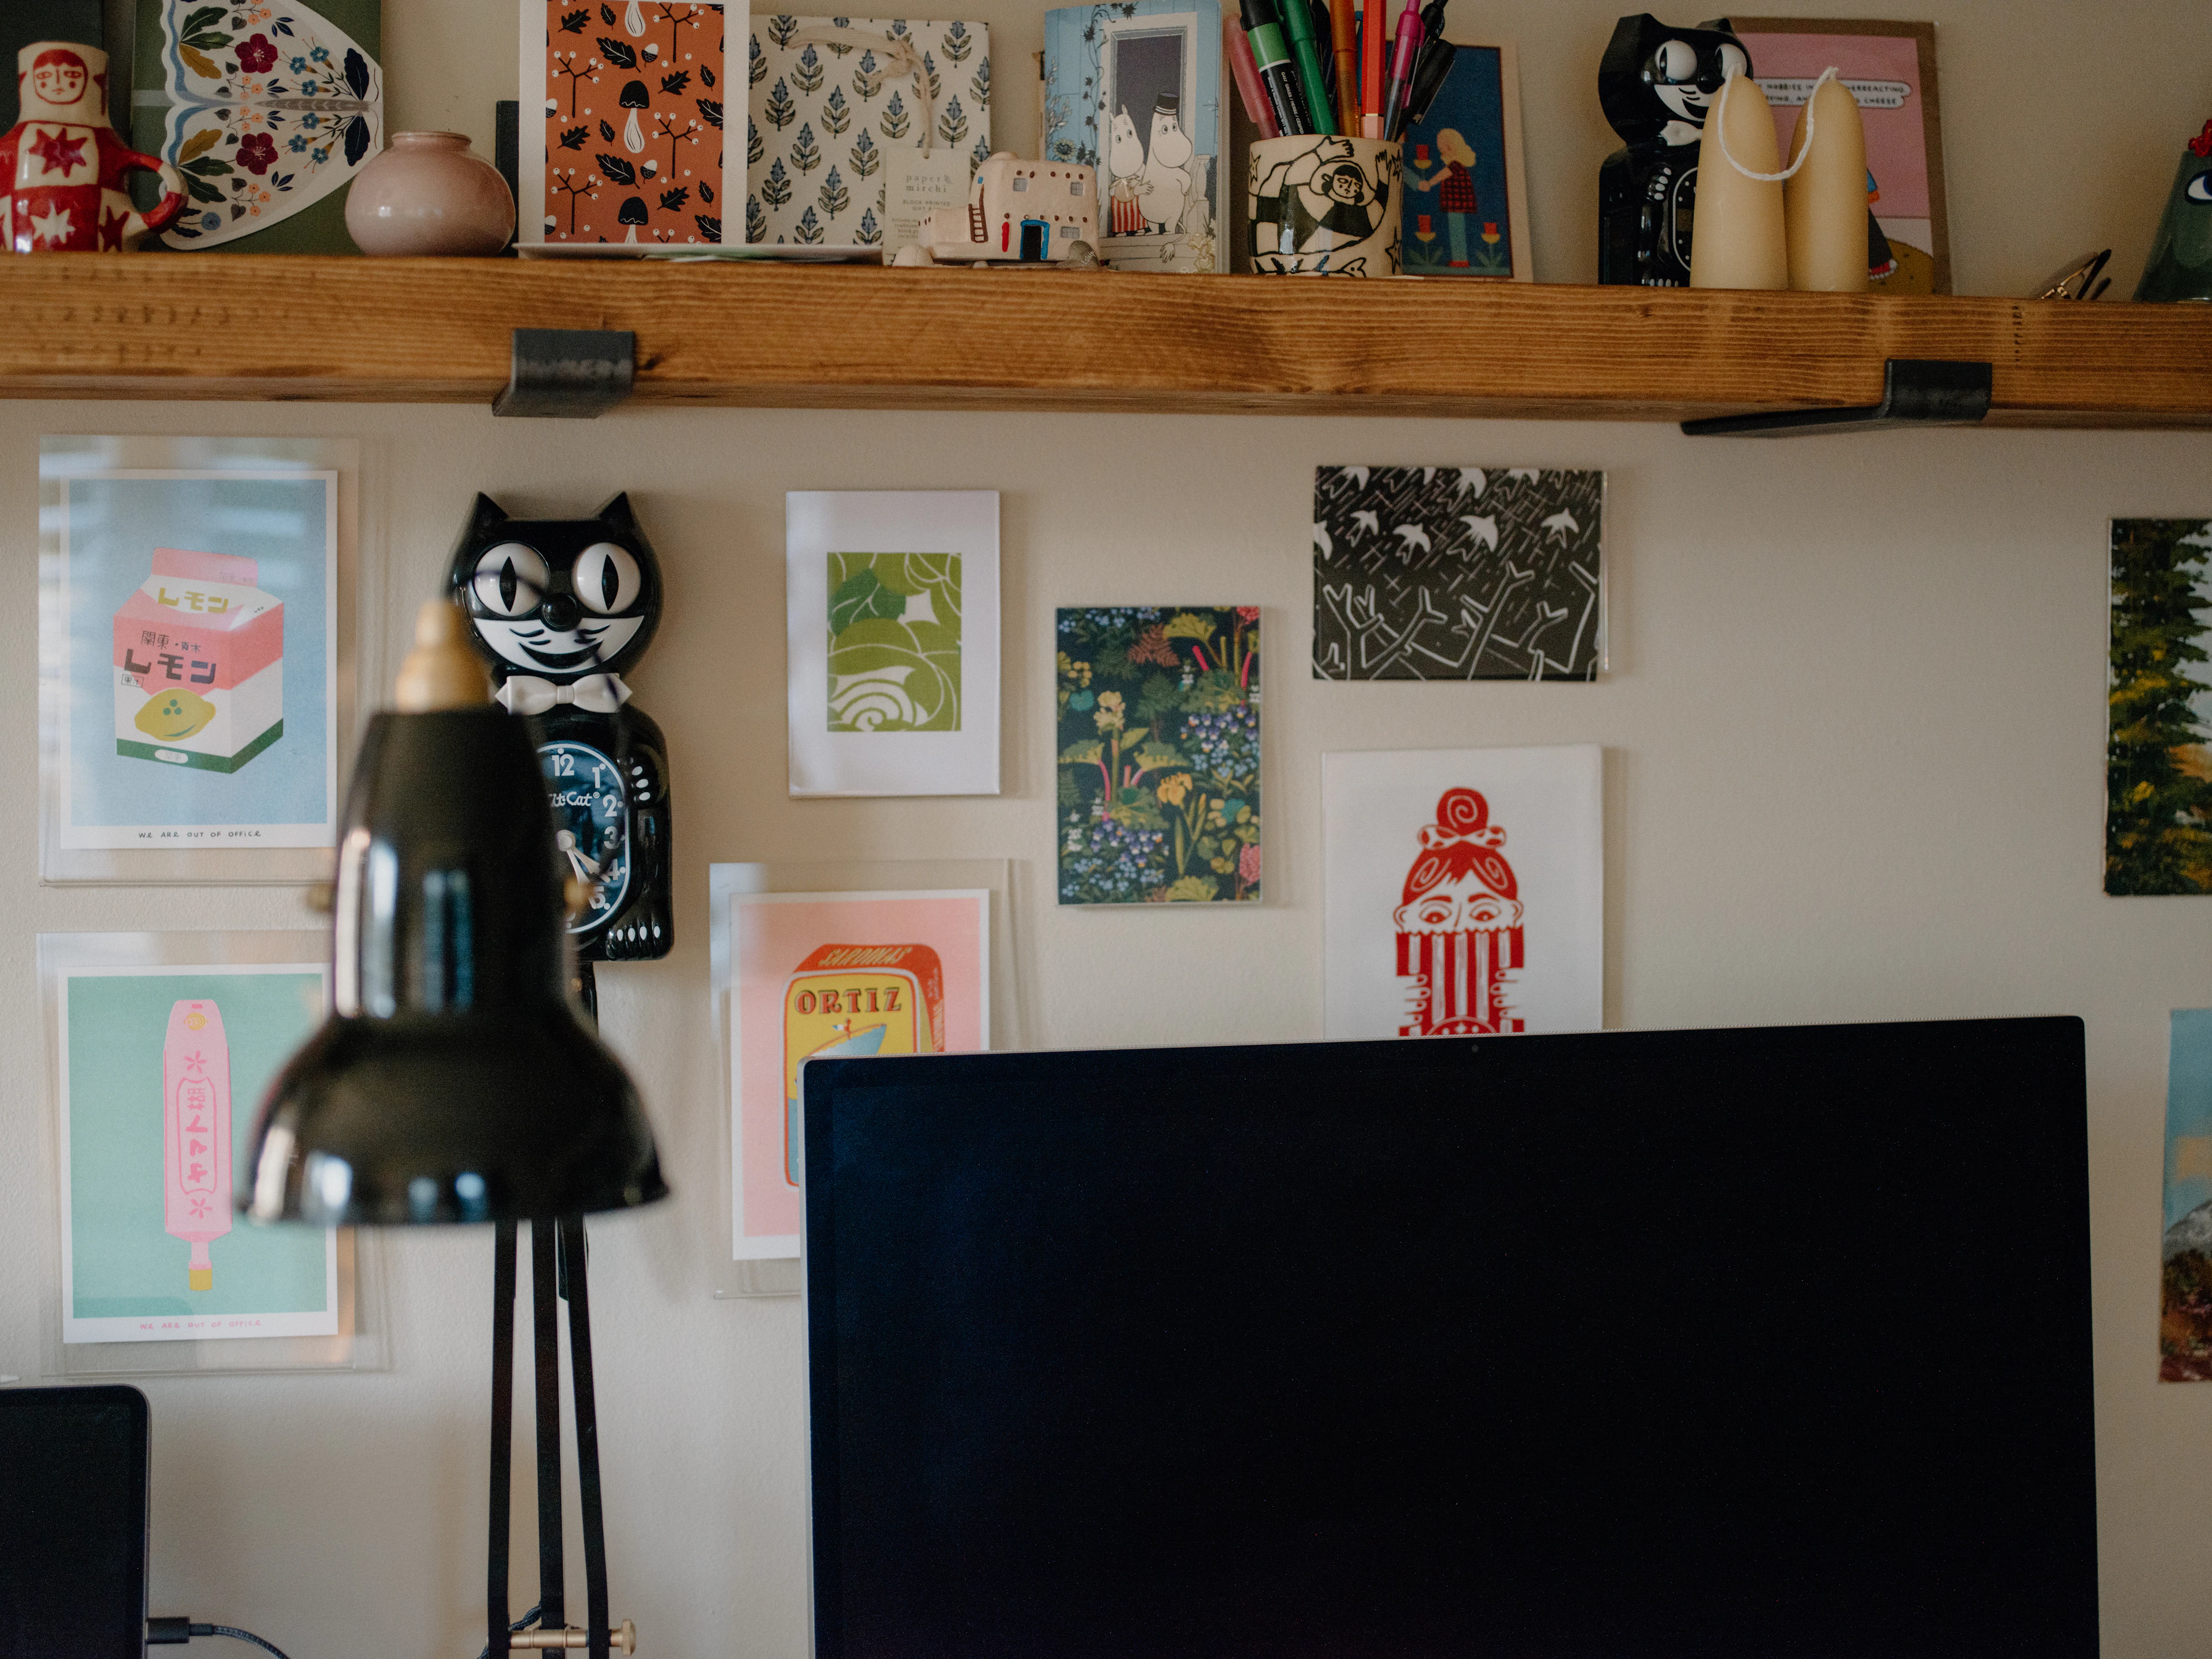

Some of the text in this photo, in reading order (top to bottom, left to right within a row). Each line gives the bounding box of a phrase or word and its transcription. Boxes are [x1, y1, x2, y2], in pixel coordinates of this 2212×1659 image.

[906, 175, 941, 183] paper
[906, 184, 946, 192] mirchi
[158, 587, 229, 615] レモン
[124, 648, 217, 684] レモン
[551, 753, 575, 777] 12
[592, 767, 601, 789] 1
[603, 794, 618, 817] 2
[604, 826, 620, 850] 3
[607, 859, 621, 881] 4
[794, 986, 902, 1015] ORTIZ
